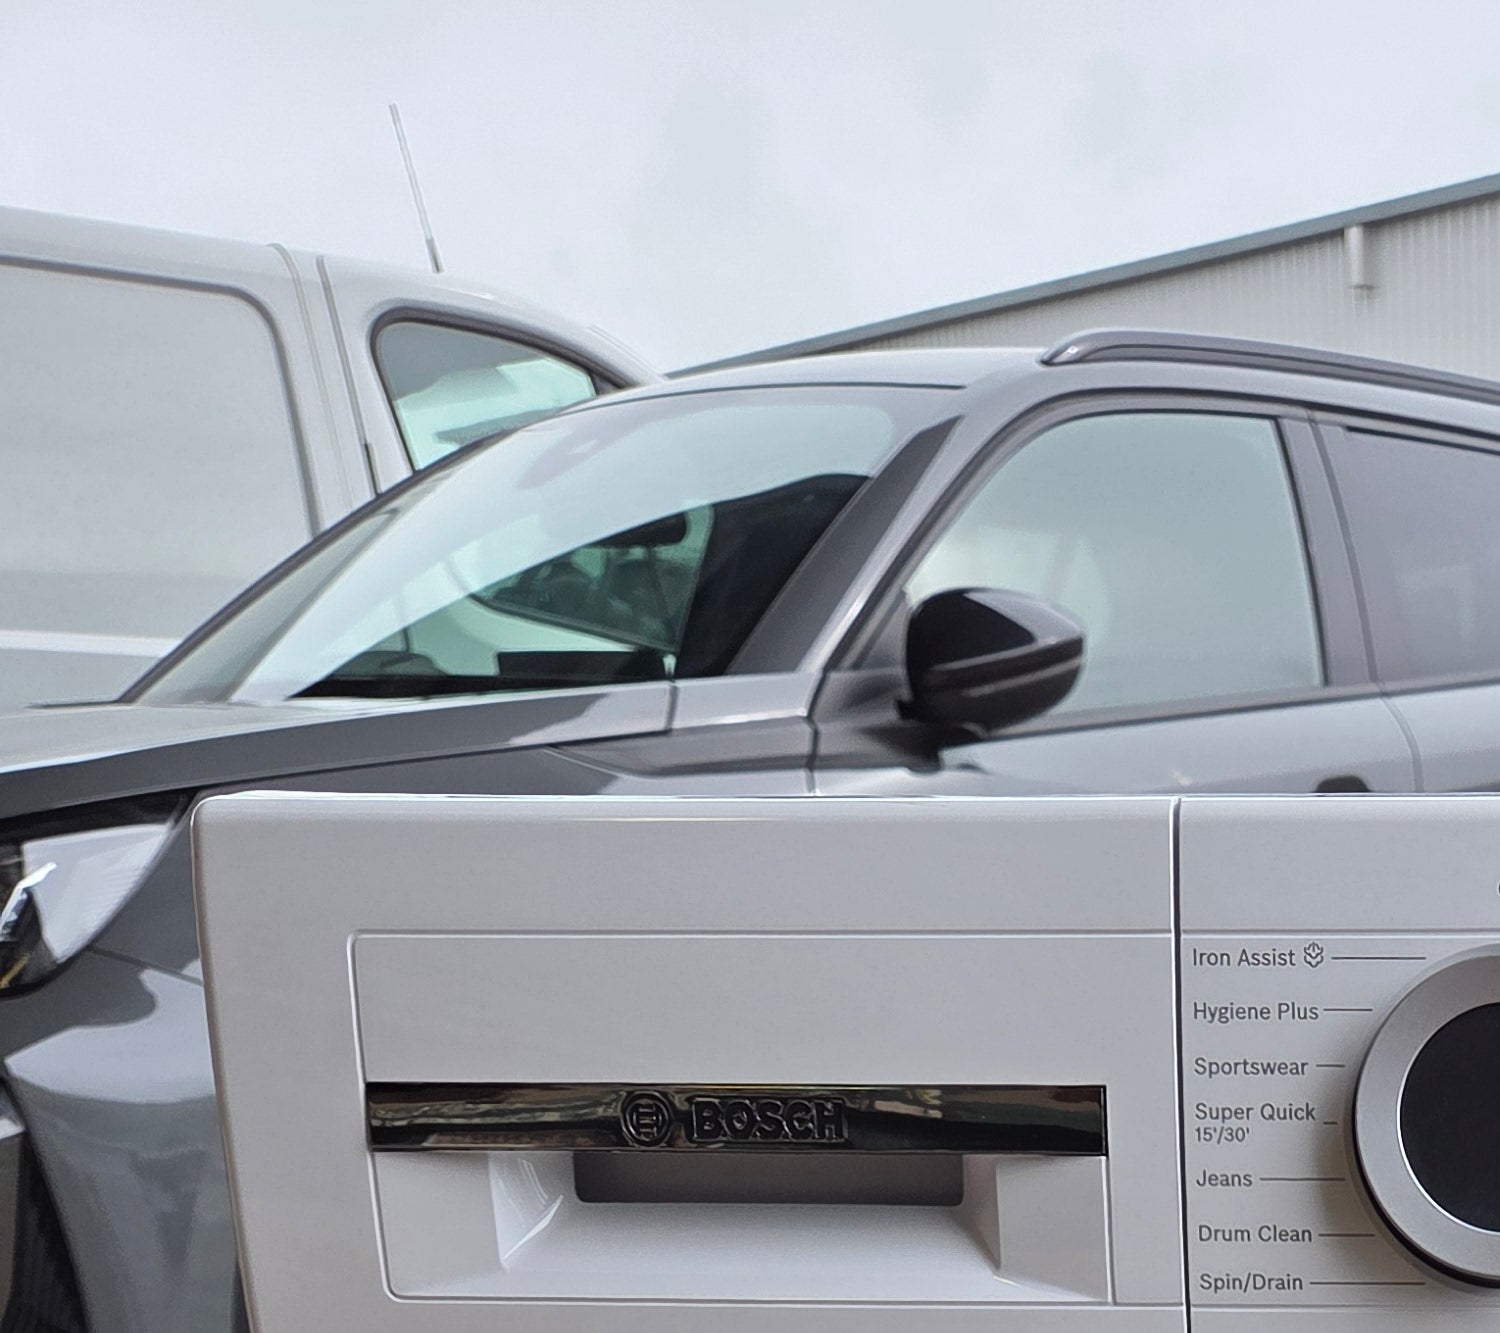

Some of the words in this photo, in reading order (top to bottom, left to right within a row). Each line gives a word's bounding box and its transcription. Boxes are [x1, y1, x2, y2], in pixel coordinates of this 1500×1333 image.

[1192, 947, 1231, 967] Iron
[1237, 948, 1296, 967] Assist
[1193, 1001, 1271, 1025] Hygiene
[1277, 1001, 1319, 1021] Plus
[1194, 1056, 1309, 1079] Sportswear
[692, 1098, 848, 1141] BOSCH
[1195, 1102, 1255, 1124] Super
[1260, 1101, 1317, 1122] Quick
[1195, 1169, 1253, 1188] Jeans
[1198, 1224, 1251, 1243] Drum
[1257, 1224, 1313, 1243] Clean
[1199, 1272, 1304, 1294] Spin/Drain
